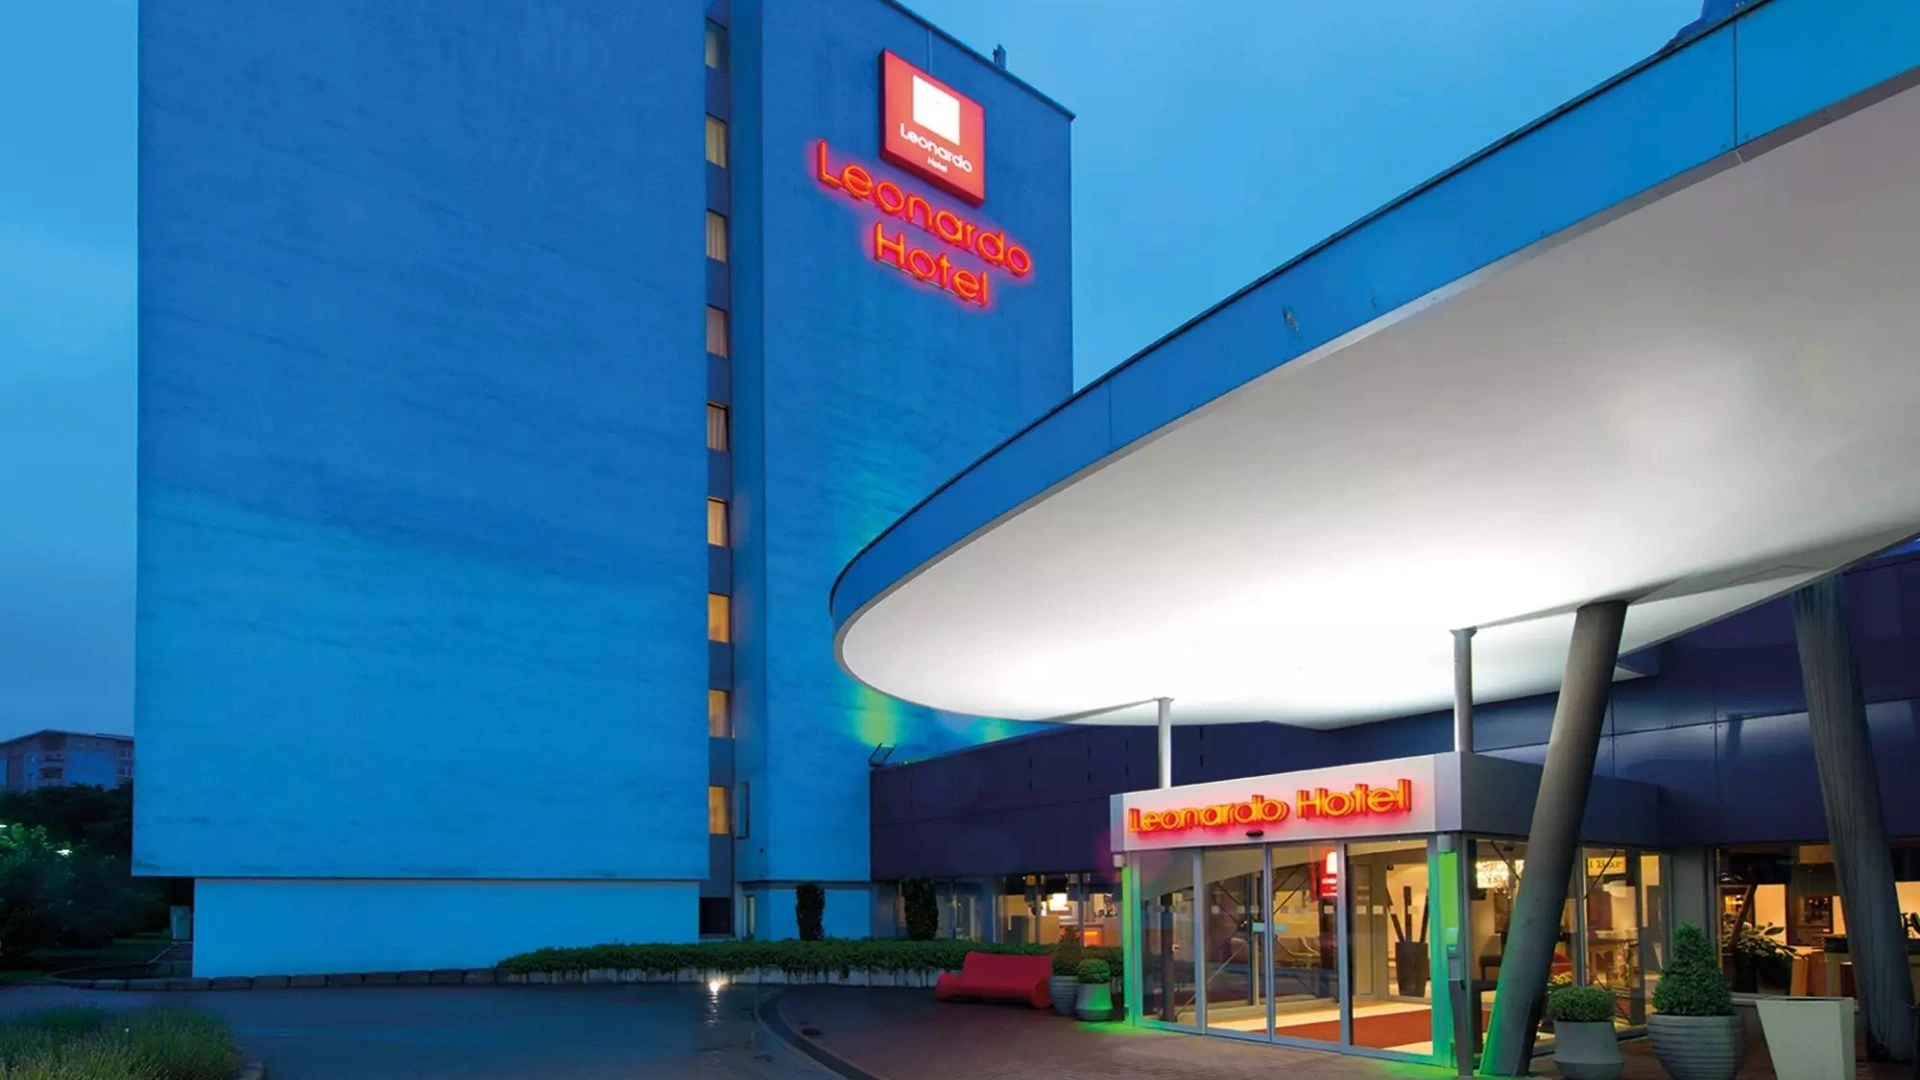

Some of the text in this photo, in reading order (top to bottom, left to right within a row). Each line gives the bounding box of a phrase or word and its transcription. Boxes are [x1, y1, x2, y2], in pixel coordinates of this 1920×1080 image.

[900, 122, 973, 172] Leonardo
[927, 156, 948, 173] Hotel
[817, 138, 1031, 277] Leonardo
[875, 221, 988, 307] Hotel
[1128, 779, 1412, 832] Leonardo Hotel
